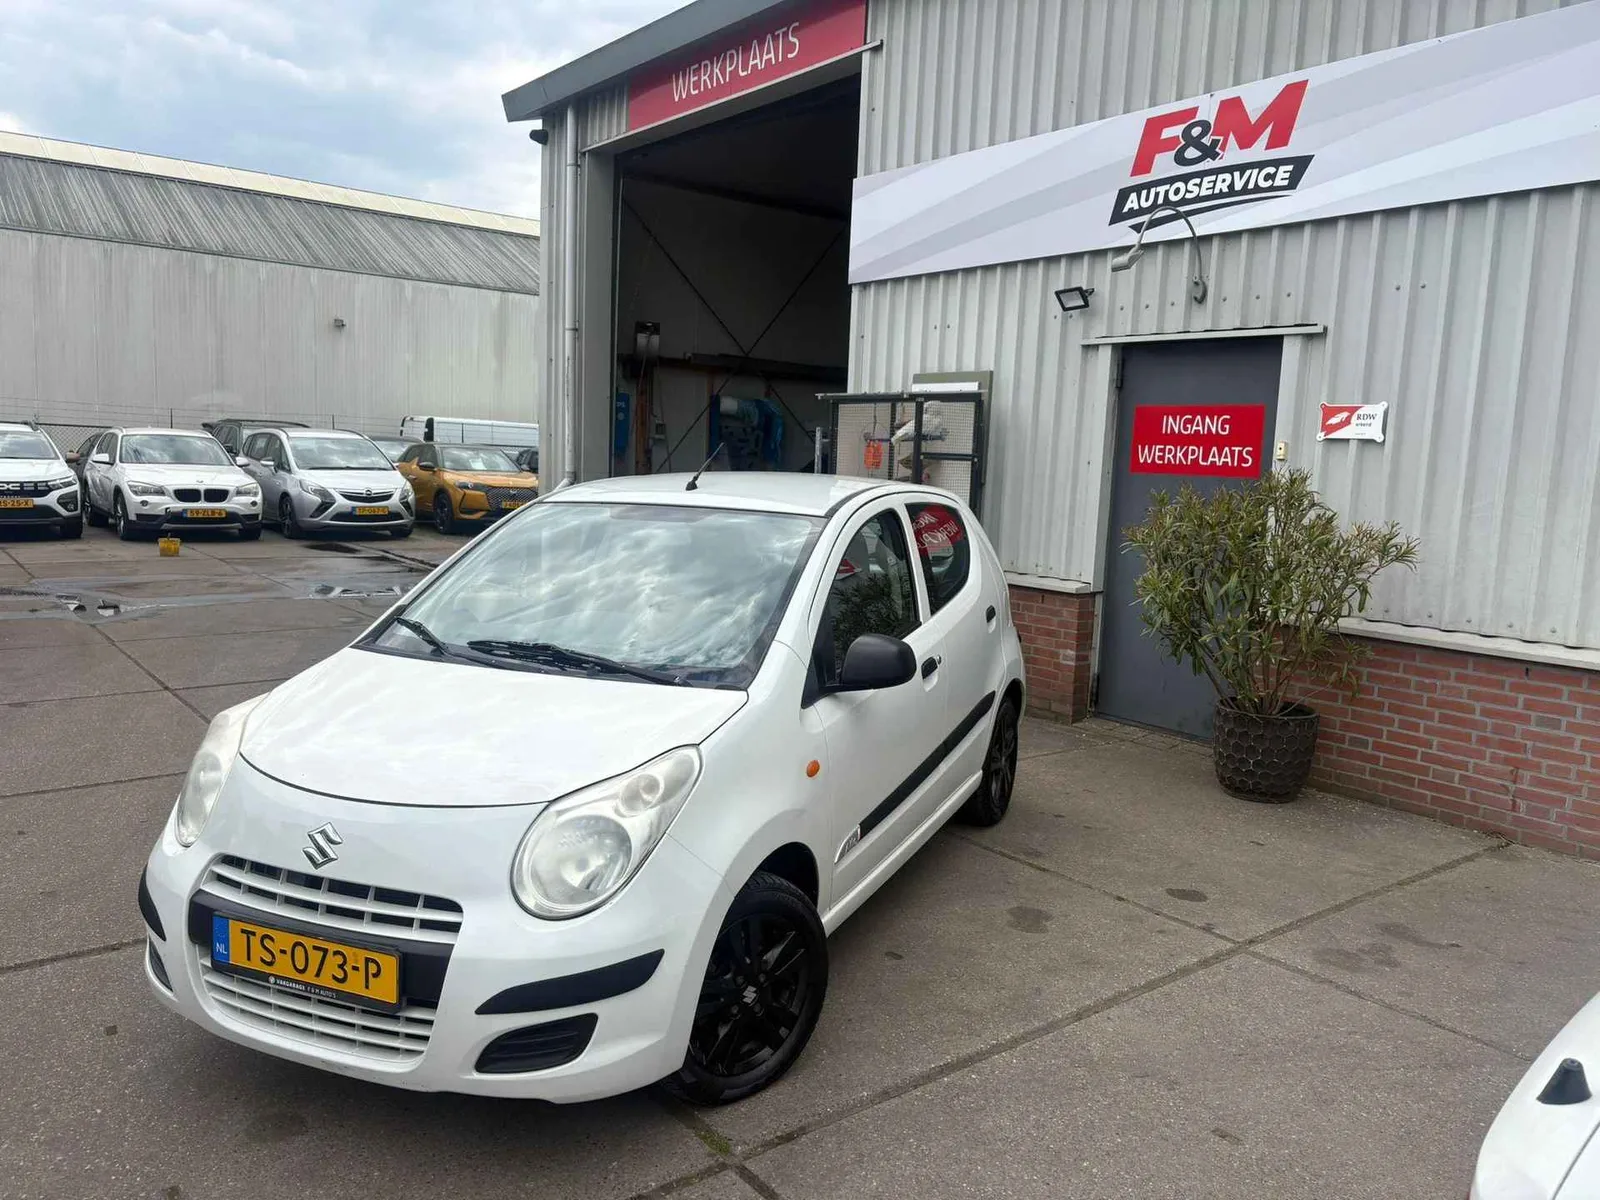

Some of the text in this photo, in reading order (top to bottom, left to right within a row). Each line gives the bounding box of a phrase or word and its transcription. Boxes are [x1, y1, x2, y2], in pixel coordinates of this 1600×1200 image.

[672, 22, 800, 102] WERKPLAATS
[1130, 79, 1309, 177] F&M
[1122, 165, 1294, 213] AUTOSERVICE
[1162, 415, 1231, 435] INGANG
[1138, 444, 1253, 467] WERKPLAATS
[216, 942, 228, 954] NL
[240, 928, 382, 990] TS-073-P
